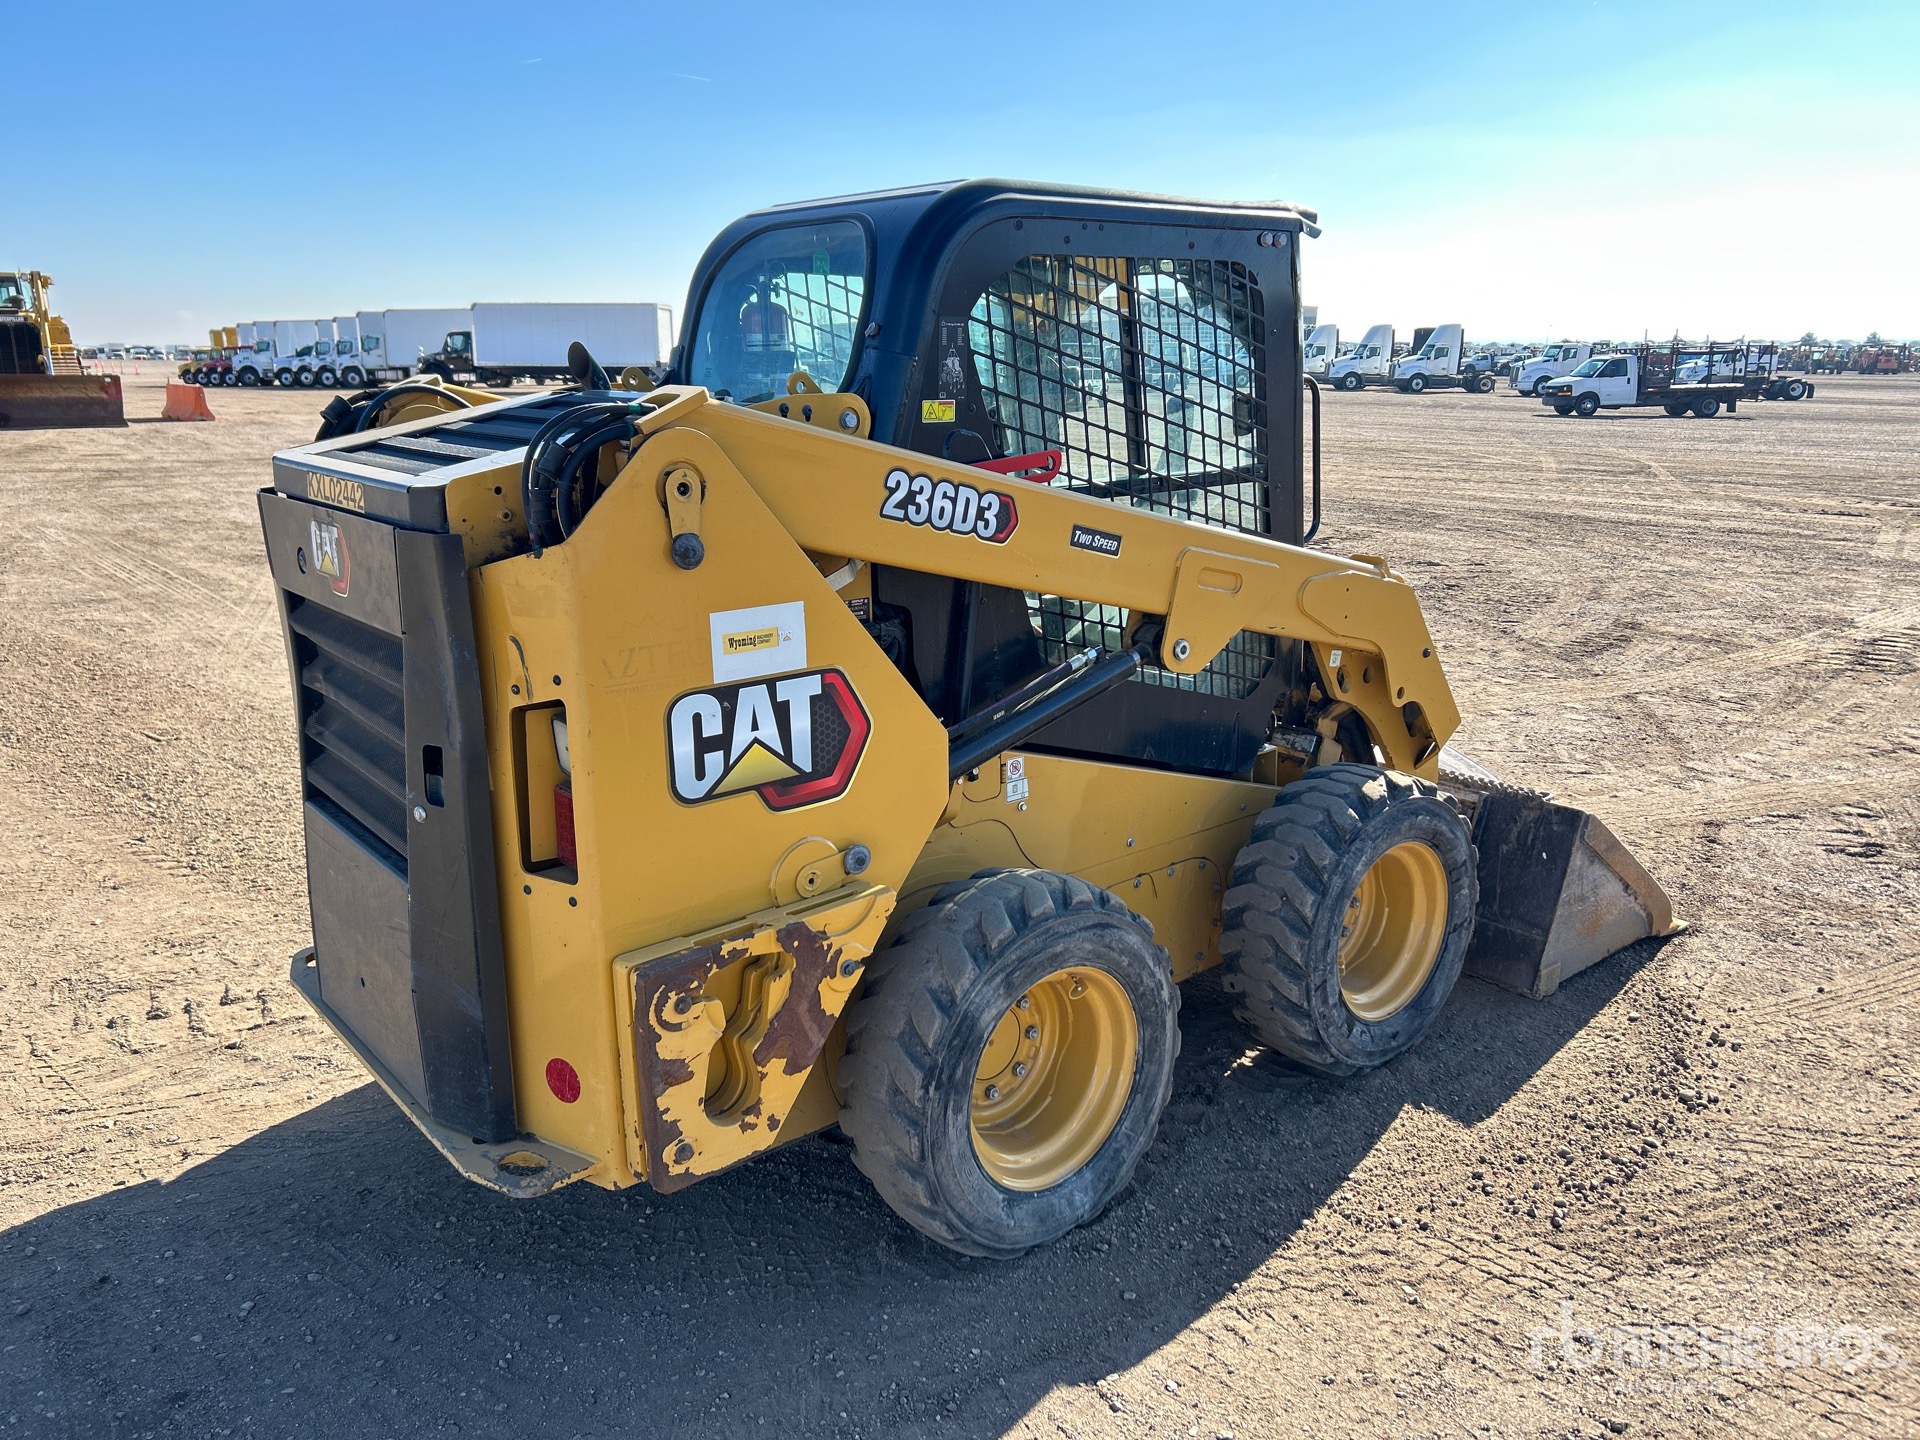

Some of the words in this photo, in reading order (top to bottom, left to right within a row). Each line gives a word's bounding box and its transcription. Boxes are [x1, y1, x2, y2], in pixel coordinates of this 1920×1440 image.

[308, 471, 364, 510] KXL02442
[882, 470, 1000, 538] 236D3
[310, 519, 339, 577] CAT
[728, 635, 757, 650] Wyoming
[671, 673, 822, 800] CAT
